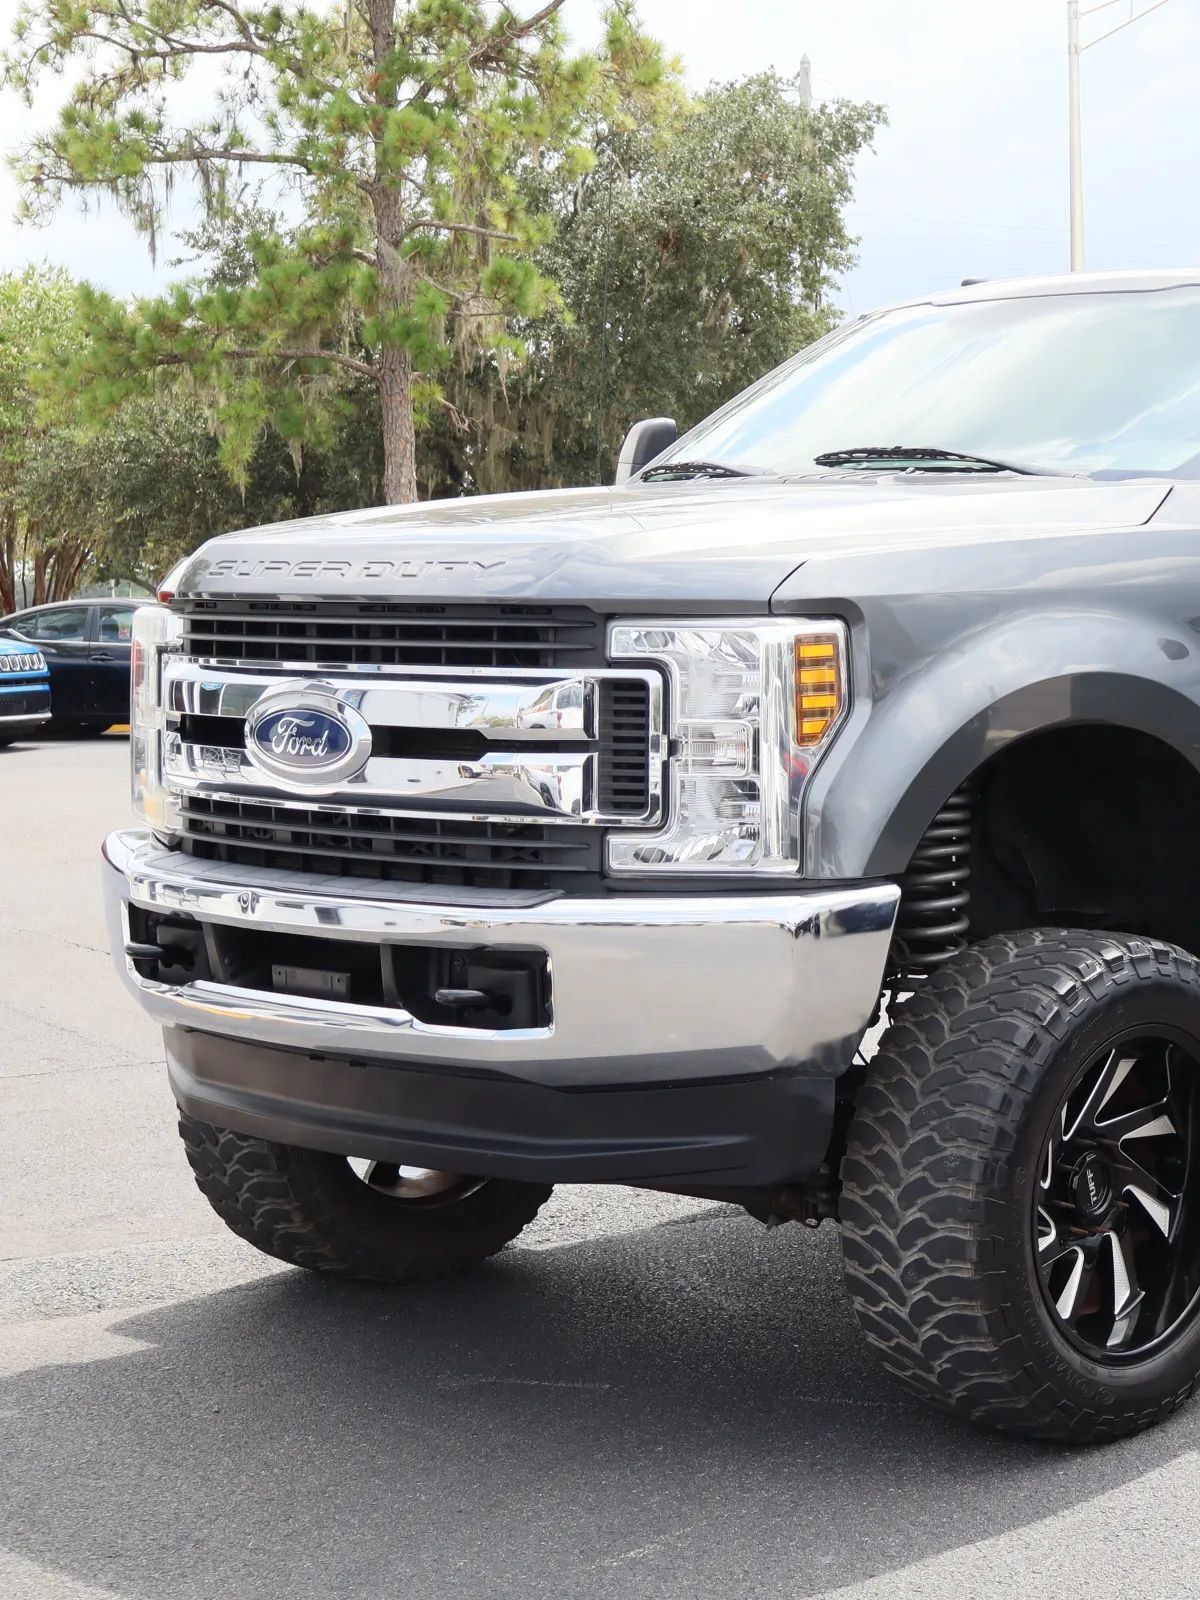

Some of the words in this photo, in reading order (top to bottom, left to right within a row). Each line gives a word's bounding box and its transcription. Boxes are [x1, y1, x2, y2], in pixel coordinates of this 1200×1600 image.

[207, 560, 352, 579] SUPER
[362, 560, 507, 580] DUTY
[271, 717, 329, 756] Ford
